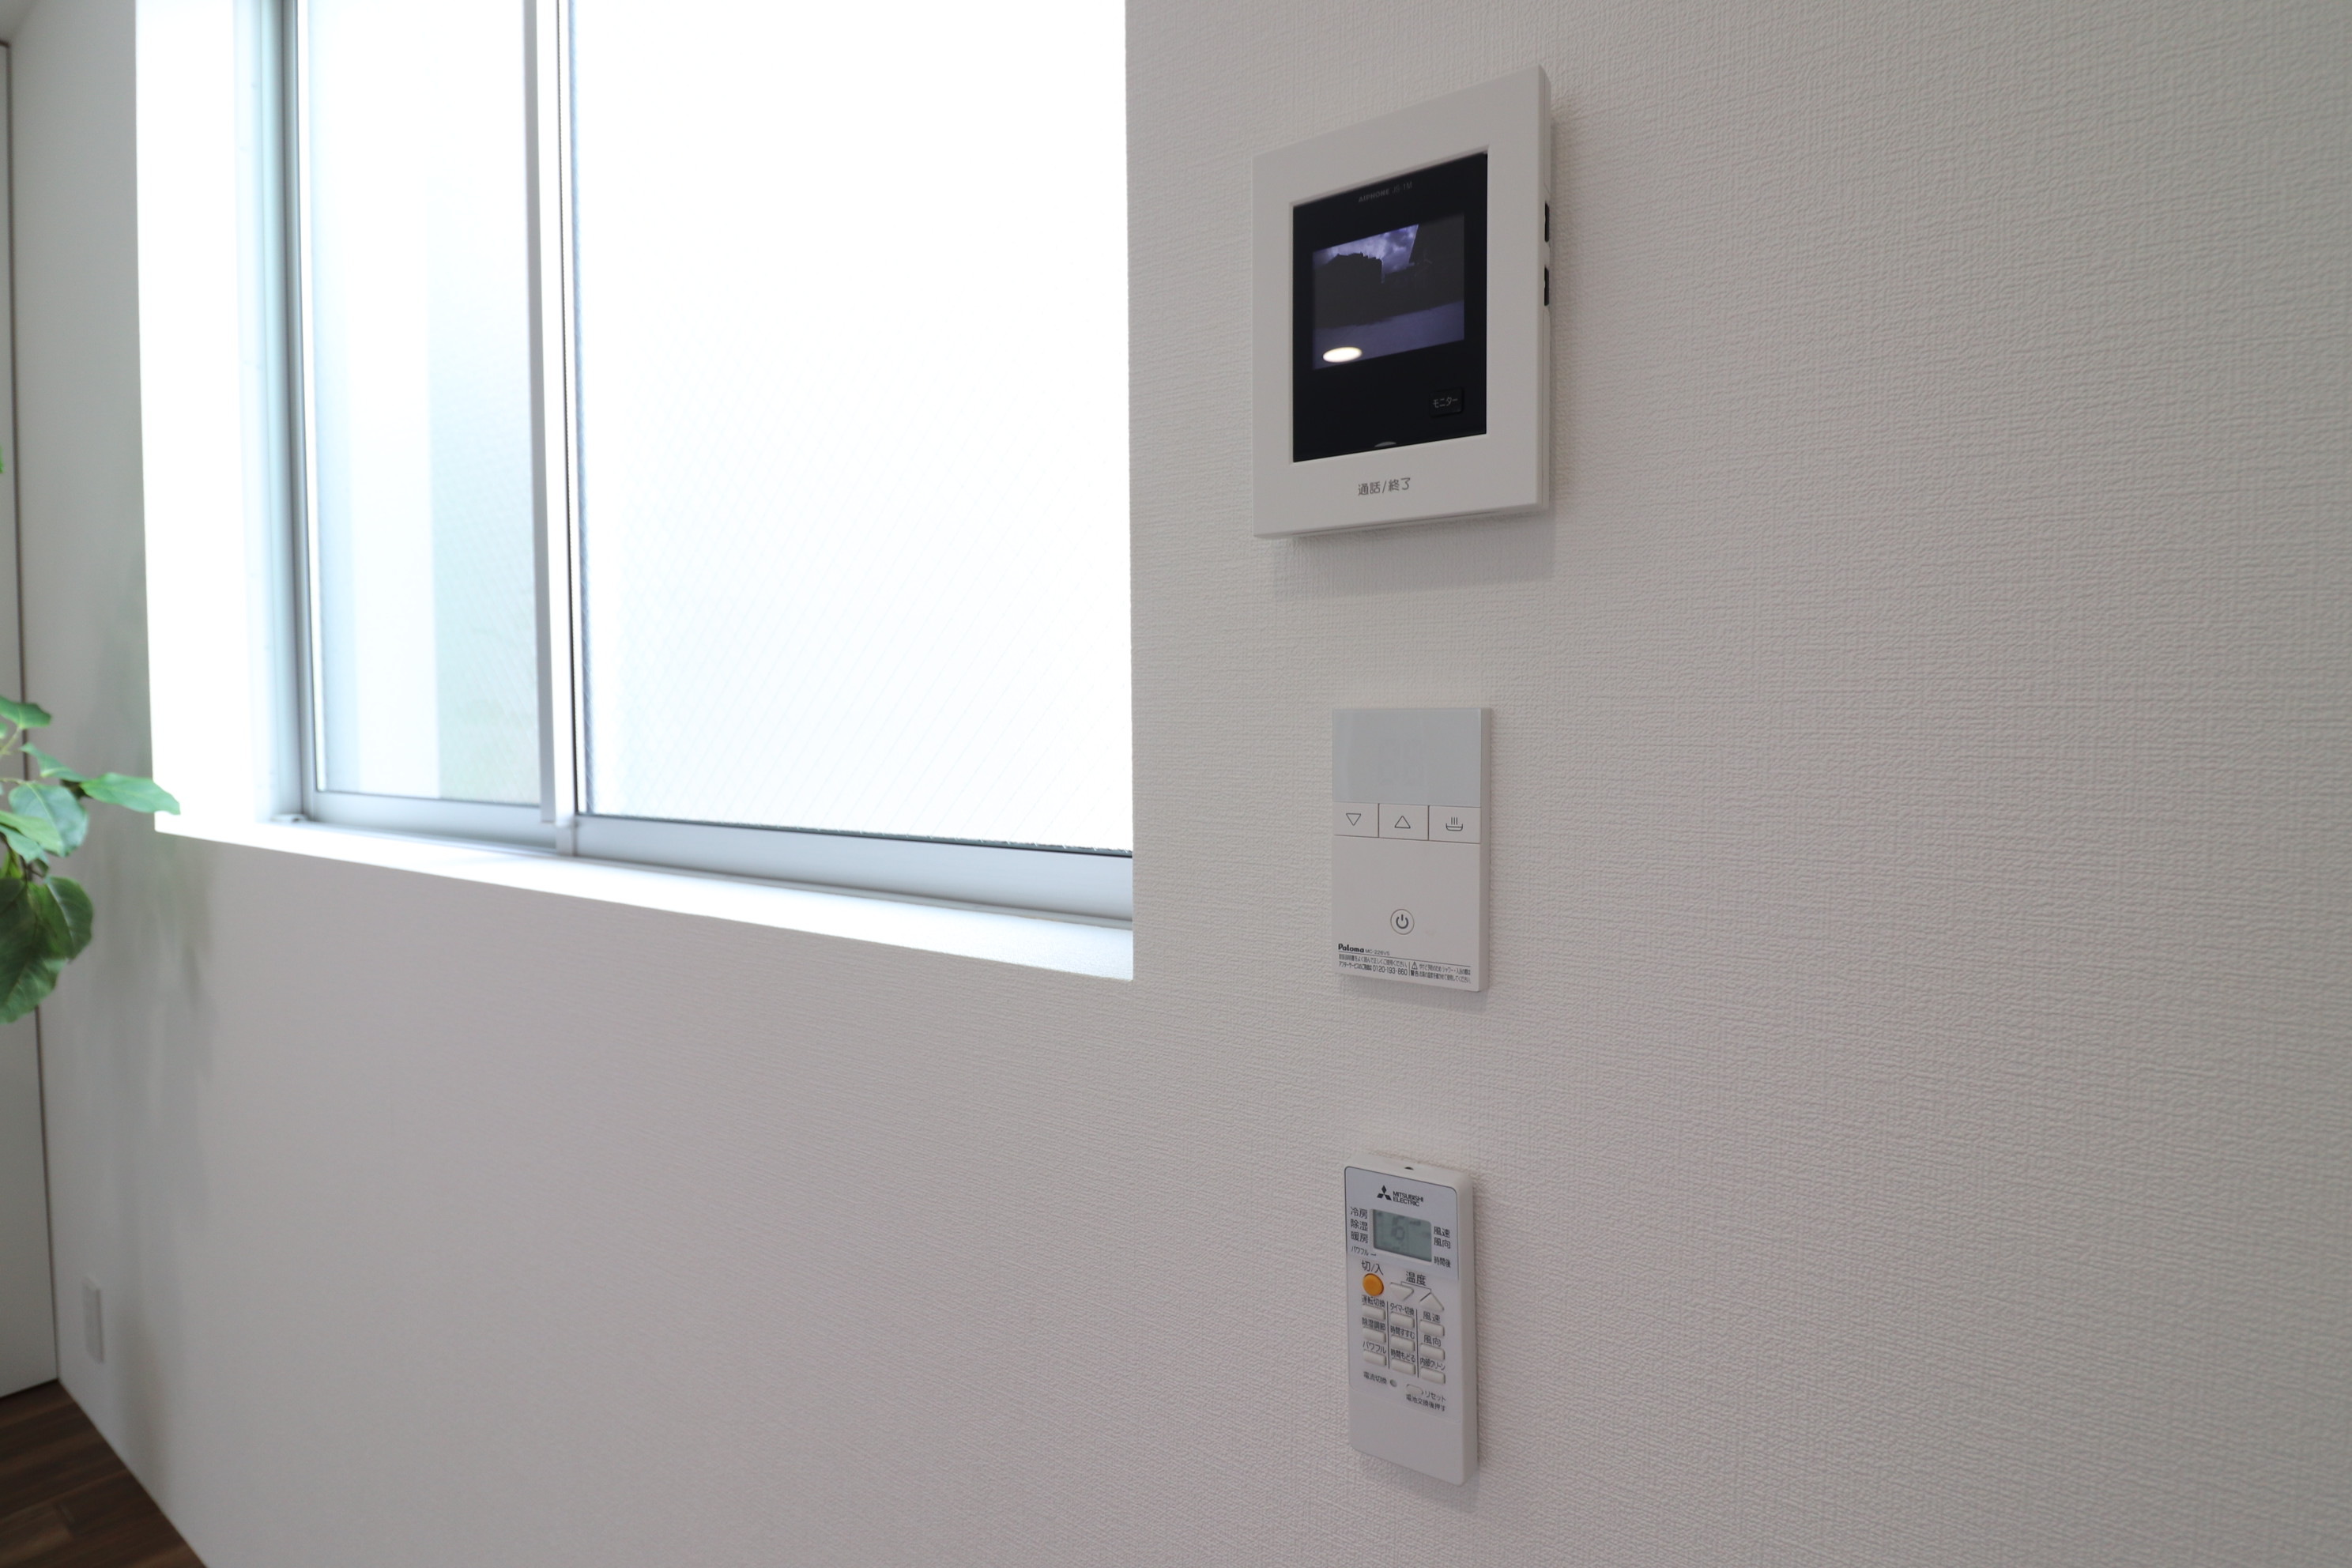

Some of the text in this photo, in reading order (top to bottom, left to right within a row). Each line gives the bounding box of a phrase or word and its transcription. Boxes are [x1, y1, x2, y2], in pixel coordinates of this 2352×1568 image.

[1359, 188, 1389, 202] AIPHONE
[1433, 397, 1458, 409] モニター
[1358, 477, 1411, 496] 通話/終了
[1338, 943, 1364, 953] Paloma
[1393, 1191, 1423, 1202] MITSUBISHI
[1393, 1197, 1419, 1207] ELECTRIC
[1351, 1207, 1368, 1219] 冷房
[1351, 1219, 1368, 1231] 除湿
[1351, 1232, 1368, 1244] 暖房
[1434, 1227, 1450, 1238] 風速
[1434, 1238, 1451, 1249] 風向
[1362, 1261, 1383, 1275] 切/入
[1406, 1271, 1427, 1286] 温度
[1362, 1295, 1385, 1308] 運転切換
[1423, 1311, 1441, 1323] 風速
[1390, 1325, 1415, 1339] 時間すすむ
[1363, 1341, 1386, 1354] パワフル
[1424, 1335, 1441, 1348] 風向
[1391, 1349, 1415, 1363] 時間もどる
[1424, 1391, 1446, 1402] リセット
[1406, 1394, 1446, 1412] 電池交換後押す
